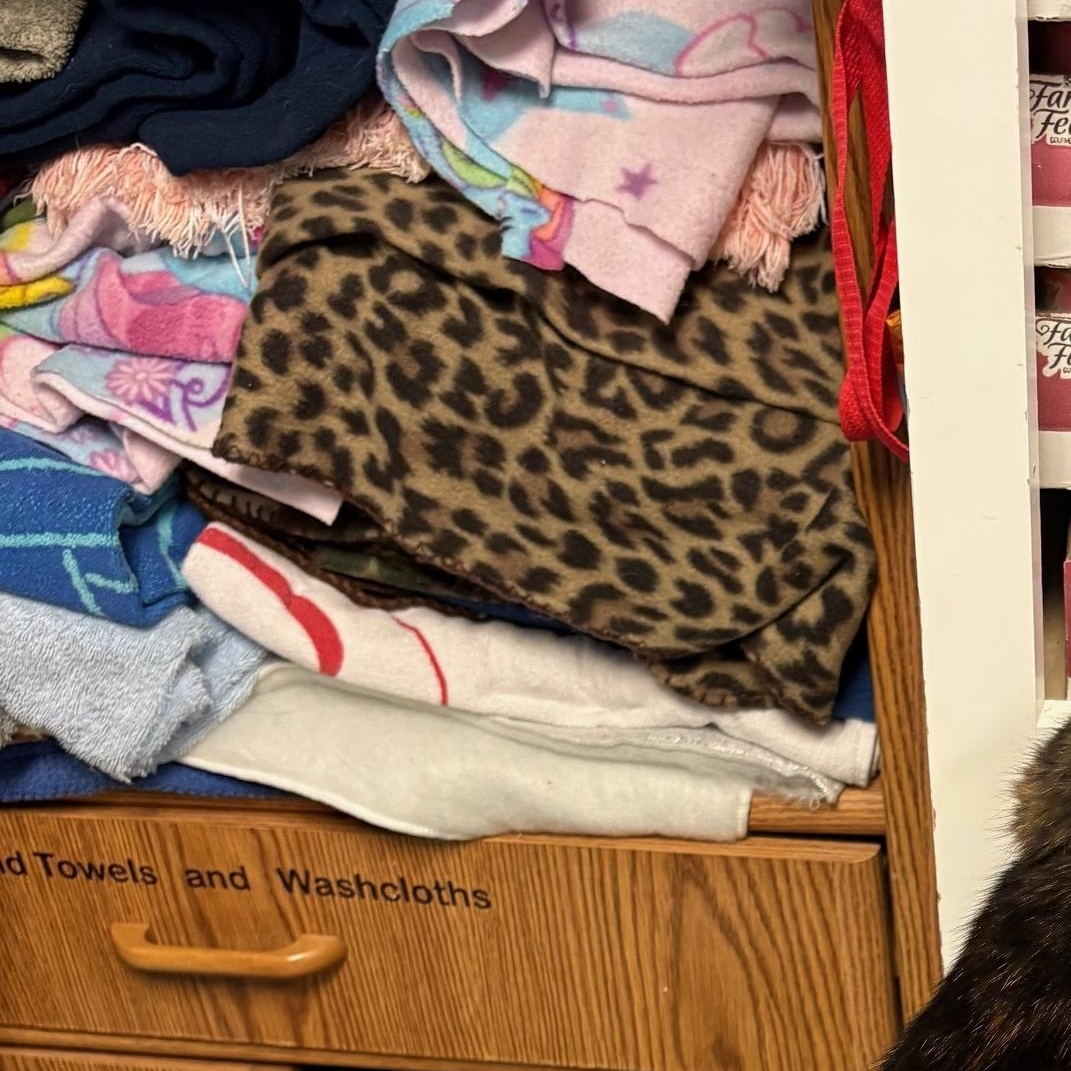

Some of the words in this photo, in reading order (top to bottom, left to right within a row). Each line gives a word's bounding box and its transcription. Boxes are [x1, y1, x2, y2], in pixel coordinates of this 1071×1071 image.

[33, 851, 158, 887] Towels
[185, 865, 251, 892] and
[275, 867, 493, 911] Washcloths
